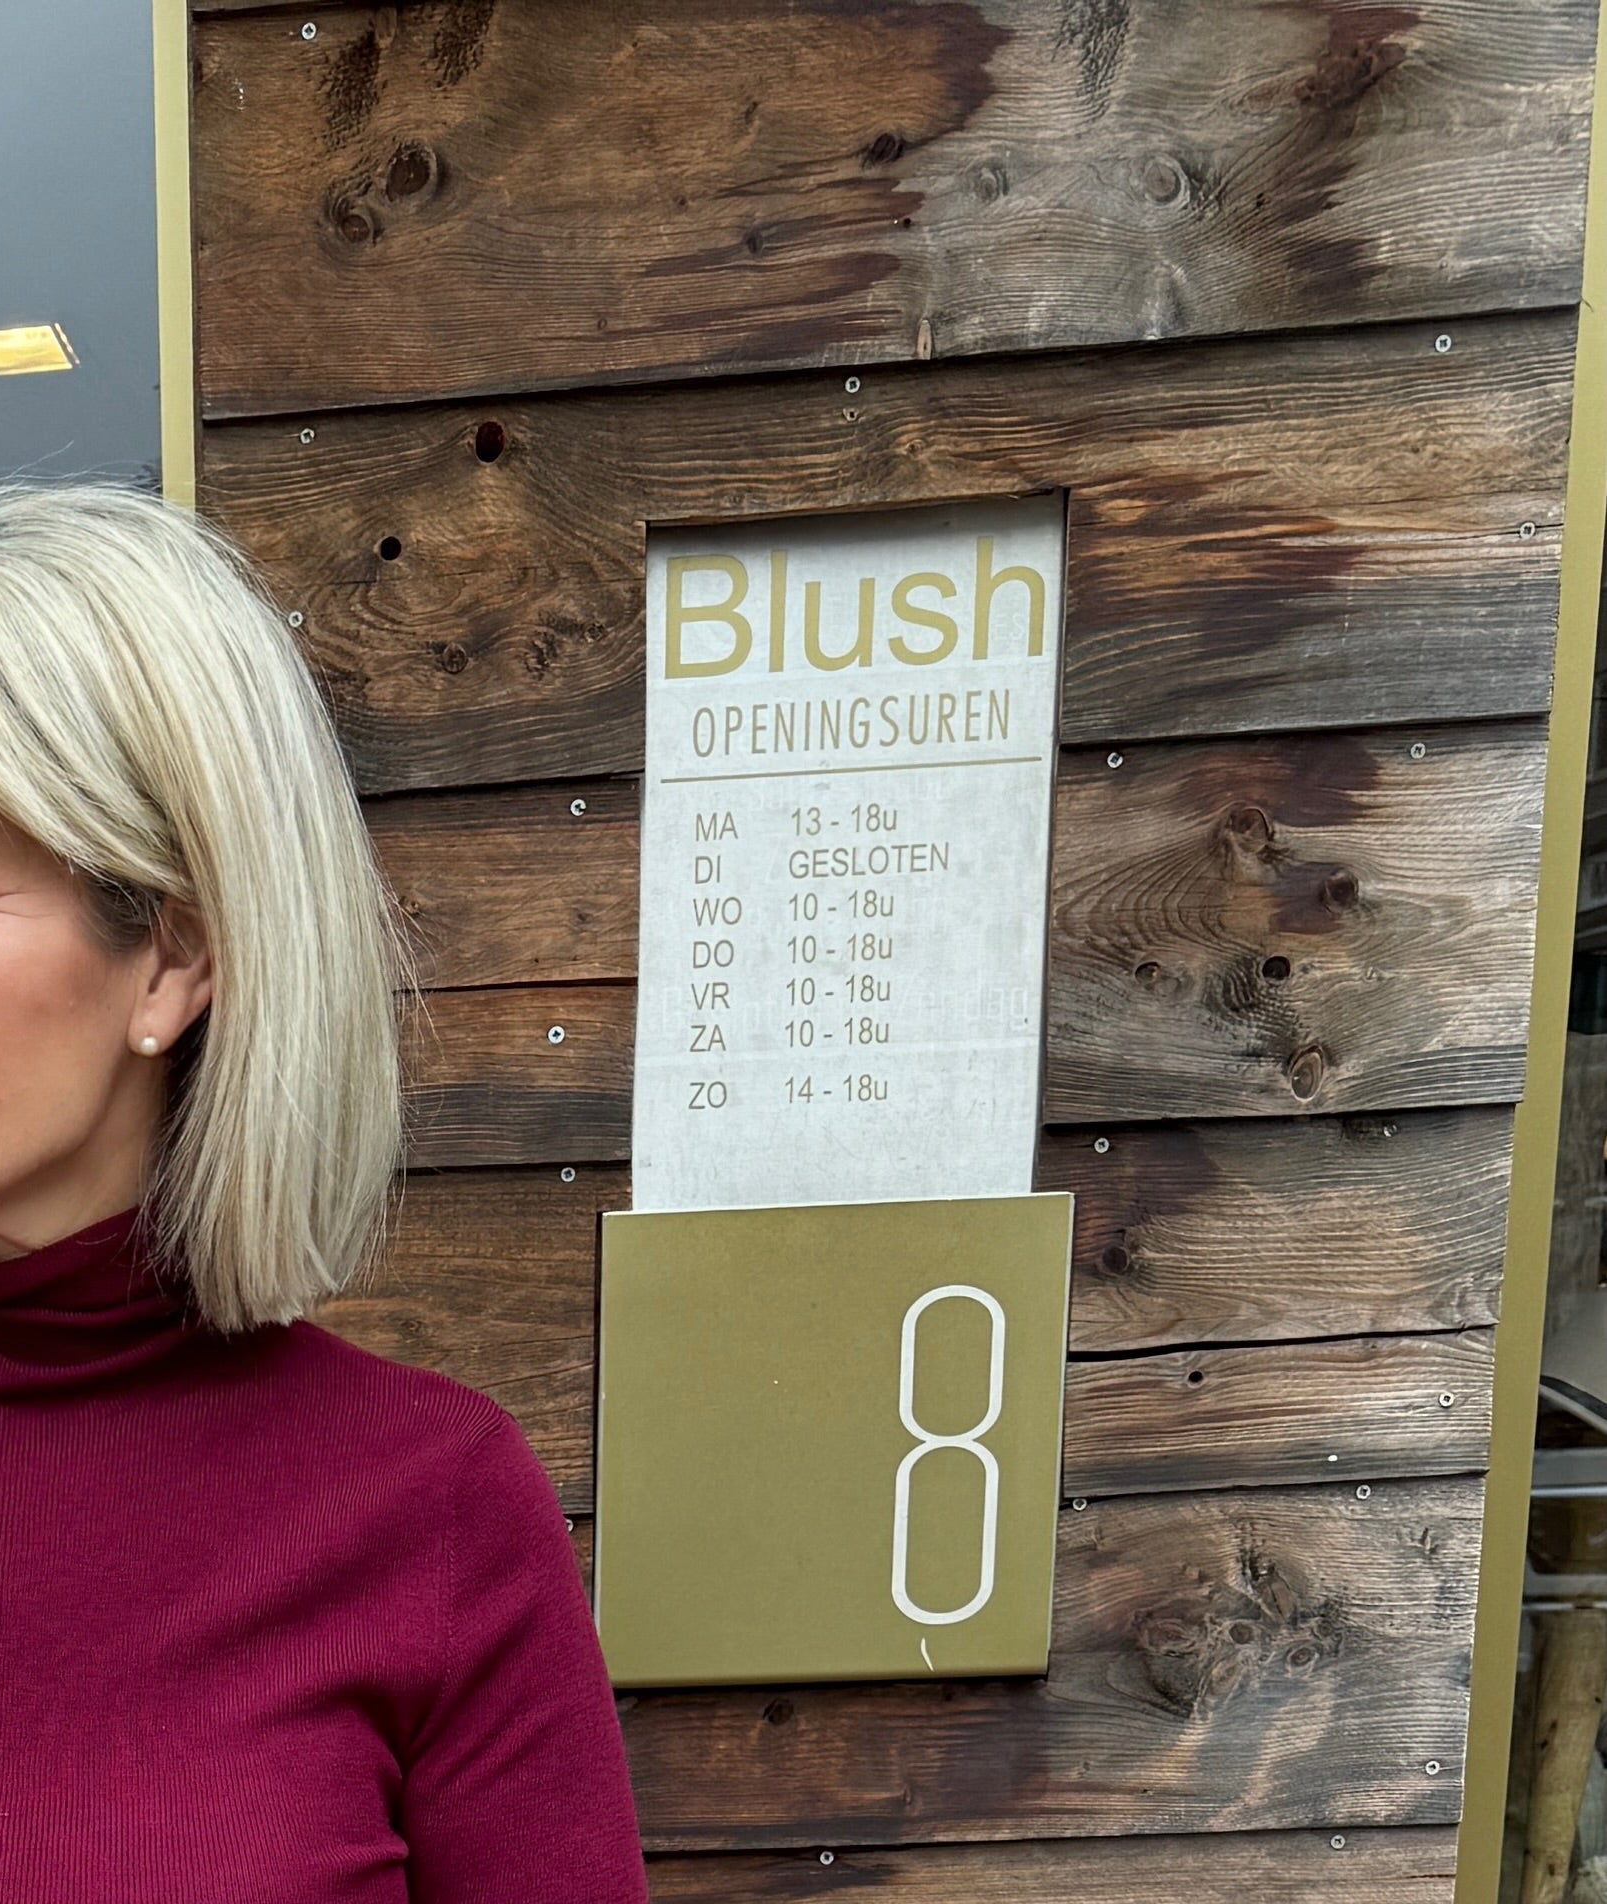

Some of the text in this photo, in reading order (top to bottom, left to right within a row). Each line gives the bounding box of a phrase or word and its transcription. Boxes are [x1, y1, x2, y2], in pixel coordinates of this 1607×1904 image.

[664, 535, 1046, 681] Blush
[693, 689, 1010, 759] OPENINGSUREN
[696, 812, 738, 842] MA
[792, 807, 821, 836] 13
[852, 803, 897, 832] 18u
[695, 842, 949, 884] DI GESLOTEN
[693, 897, 742, 926] WO
[789, 893, 818, 921] 10
[849, 890, 893, 918] 18u
[693, 940, 734, 969] DO
[788, 935, 816, 963] 10
[848, 933, 892, 961] 18u
[691, 982, 730, 1010] VR
[787, 978, 815, 1006] 10
[846, 974, 890, 1003] 18u
[690, 1024, 726, 1052] ZA
[785, 1020, 813, 1048] 10
[845, 1017, 889, 1045] 18u
[688, 1081, 727, 1109] ZO
[786, 1076, 813, 1103] 14
[843, 1074, 887, 1102] 18u
[892, 1285, 1005, 1625] 8
